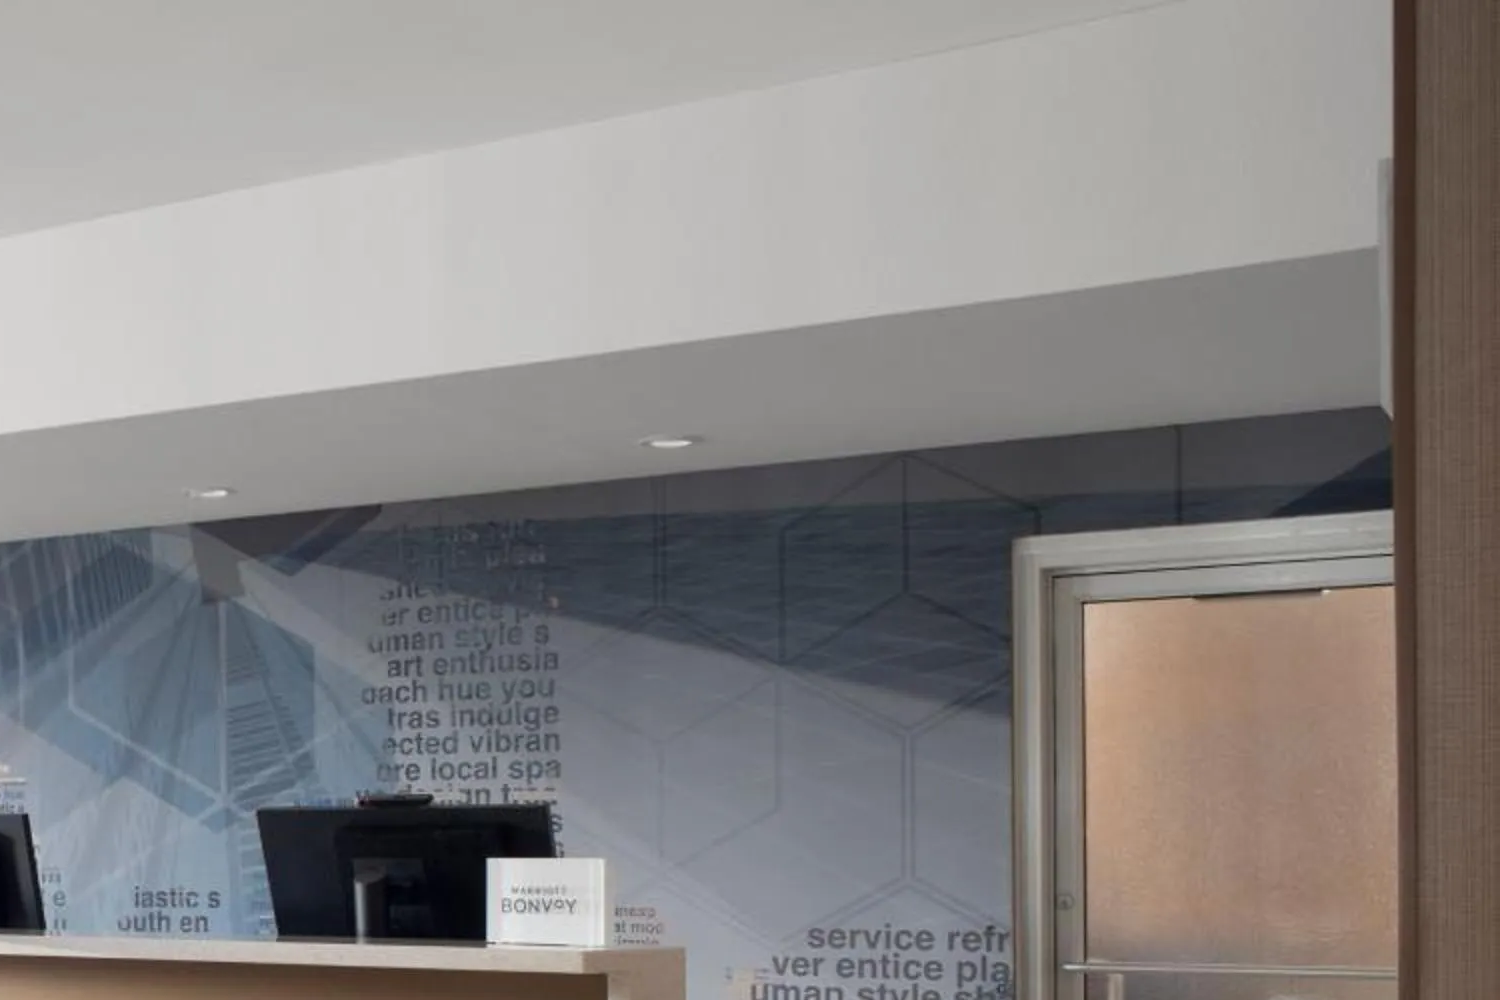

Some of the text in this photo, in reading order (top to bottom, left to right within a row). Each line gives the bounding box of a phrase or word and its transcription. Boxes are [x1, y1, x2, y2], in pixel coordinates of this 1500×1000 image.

[387, 650, 560, 677] art enthusia
[438, 676, 492, 700] hue
[502, 678, 555, 703] you
[451, 703, 560, 731] indulge
[469, 729, 561, 753] vibran
[430, 756, 497, 780] local
[507, 759, 562, 785] spa
[501, 897, 577, 915] BONVOY
[180, 915, 209, 933] en
[807, 922, 1011, 952] service refr
[771, 952, 1011, 989] ver entice pla
